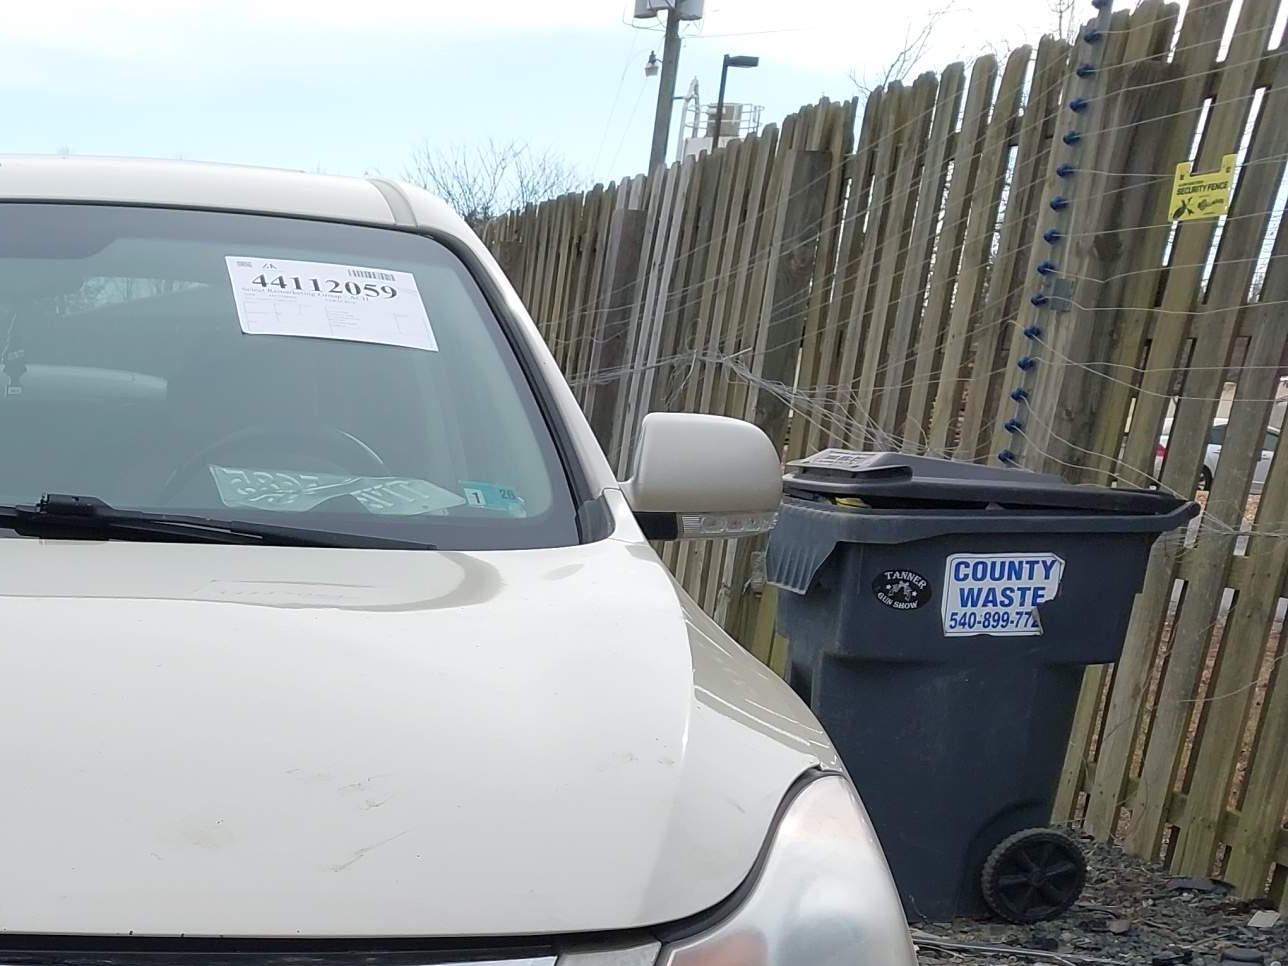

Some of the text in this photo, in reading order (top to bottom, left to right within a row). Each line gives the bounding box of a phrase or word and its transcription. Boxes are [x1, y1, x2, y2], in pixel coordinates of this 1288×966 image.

[1176, 185, 1208, 196] SECURITY
[1208, 181, 1229, 192] FENCE
[252, 273, 398, 299] 44112059
[884, 571, 927, 590] TANNER
[954, 560, 1057, 582] COUNTY
[877, 592, 918, 609] GUN SHOW
[959, 586, 1046, 608] WASTE
